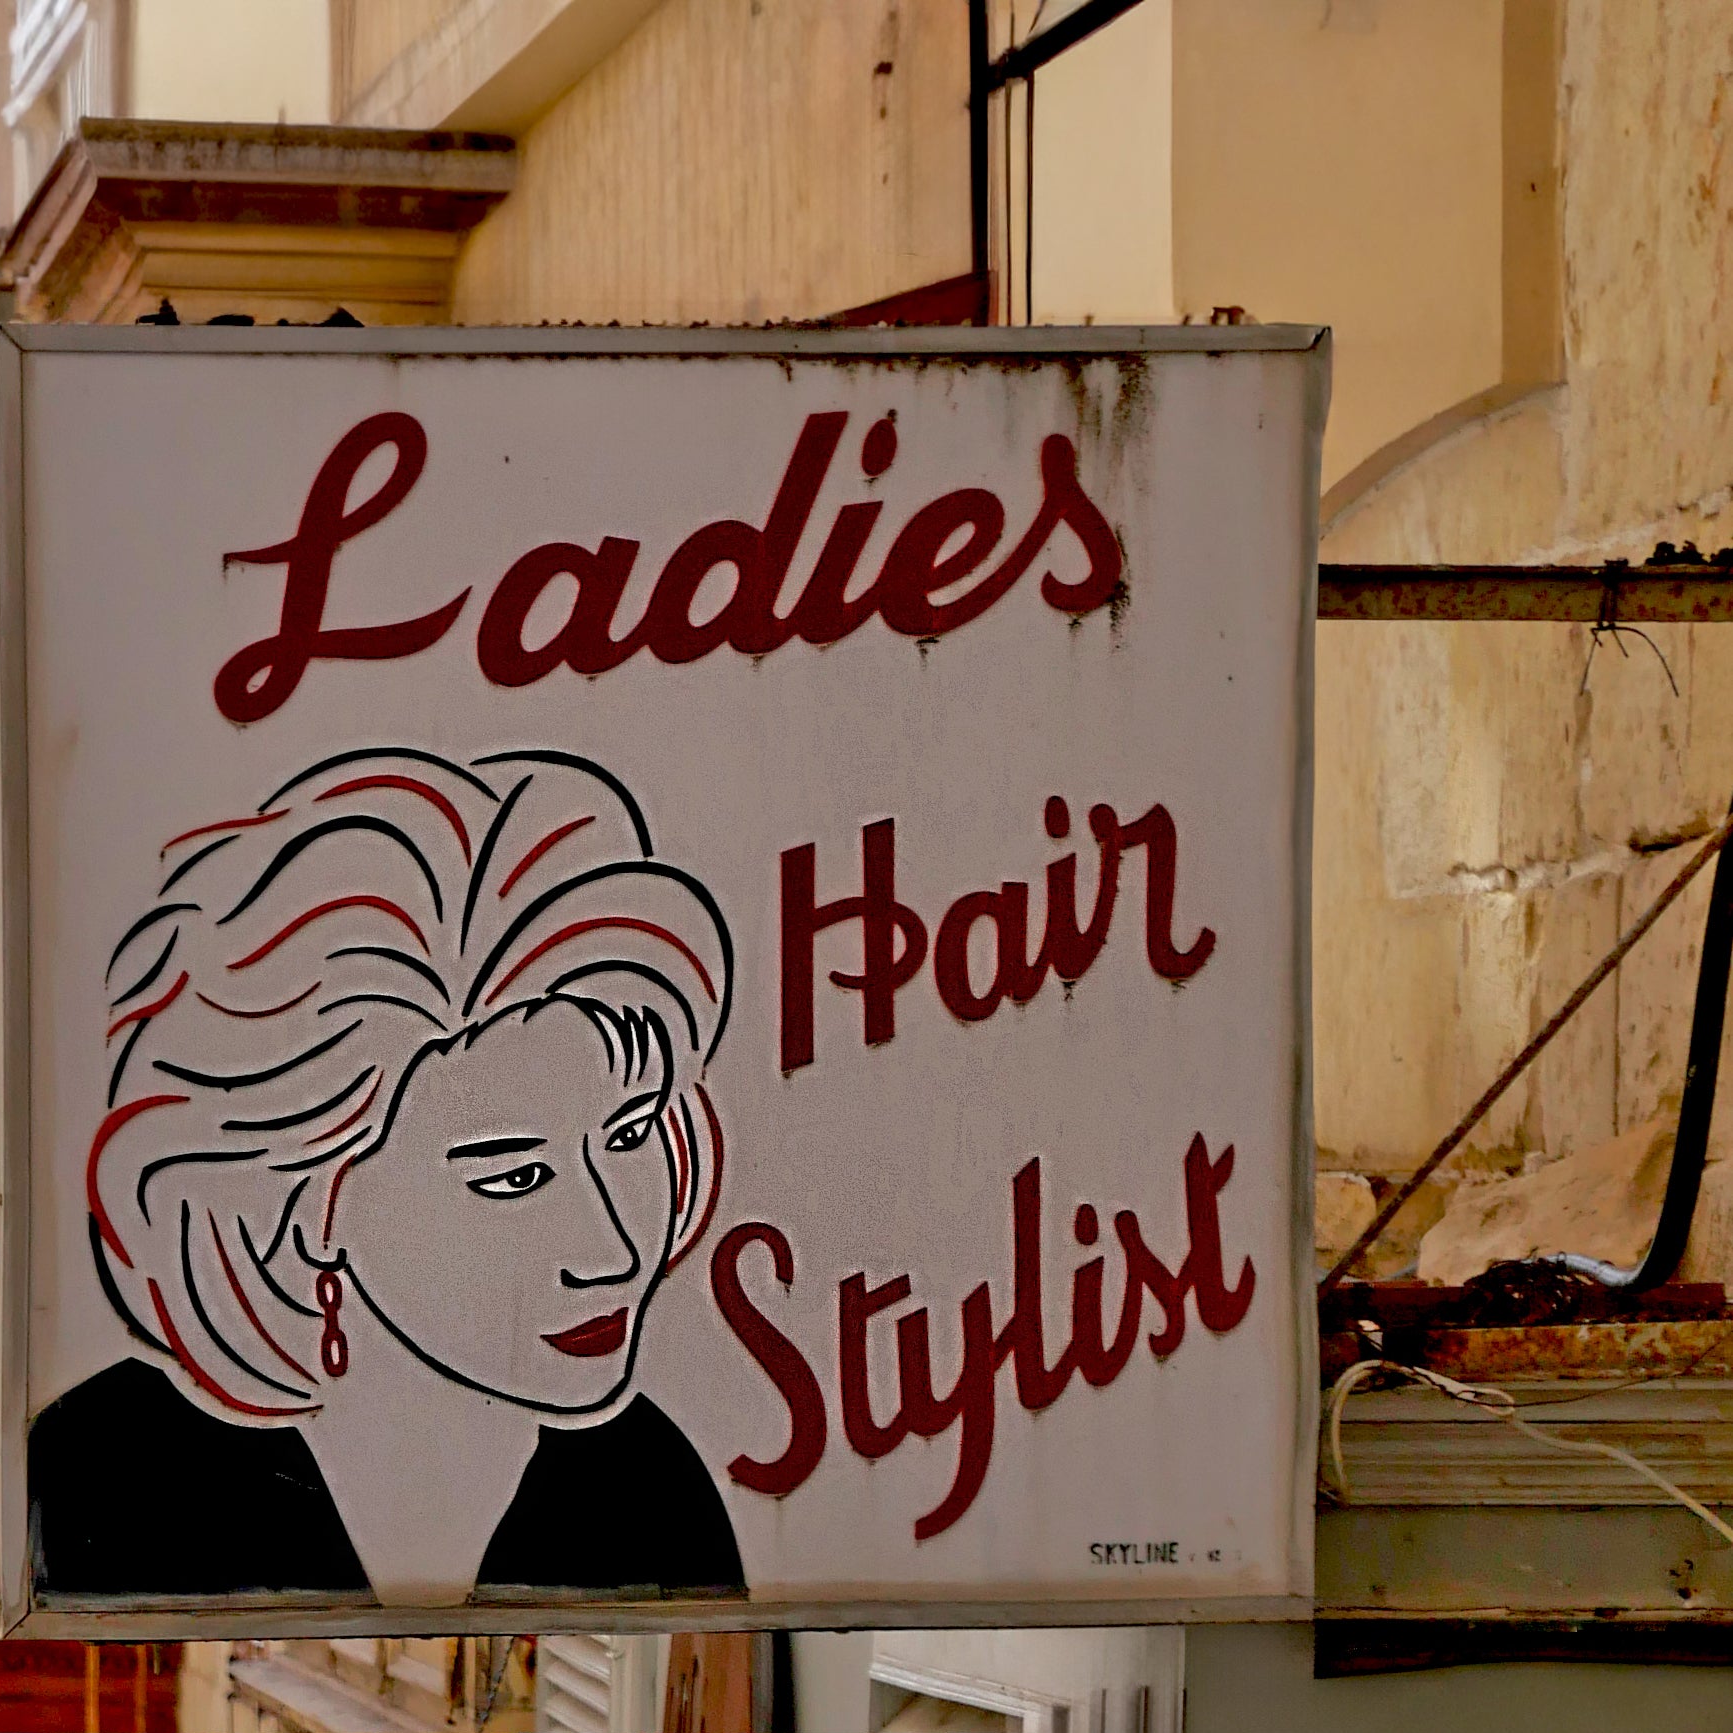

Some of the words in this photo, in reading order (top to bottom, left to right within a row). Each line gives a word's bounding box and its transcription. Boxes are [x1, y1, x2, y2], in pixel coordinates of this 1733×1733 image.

[213, 410, 1124, 722] Ladies
[779, 795, 1217, 1073] Hair
[710, 1131, 1256, 1541] Stylist
[1090, 1542, 1179, 1565] SKYLINE
